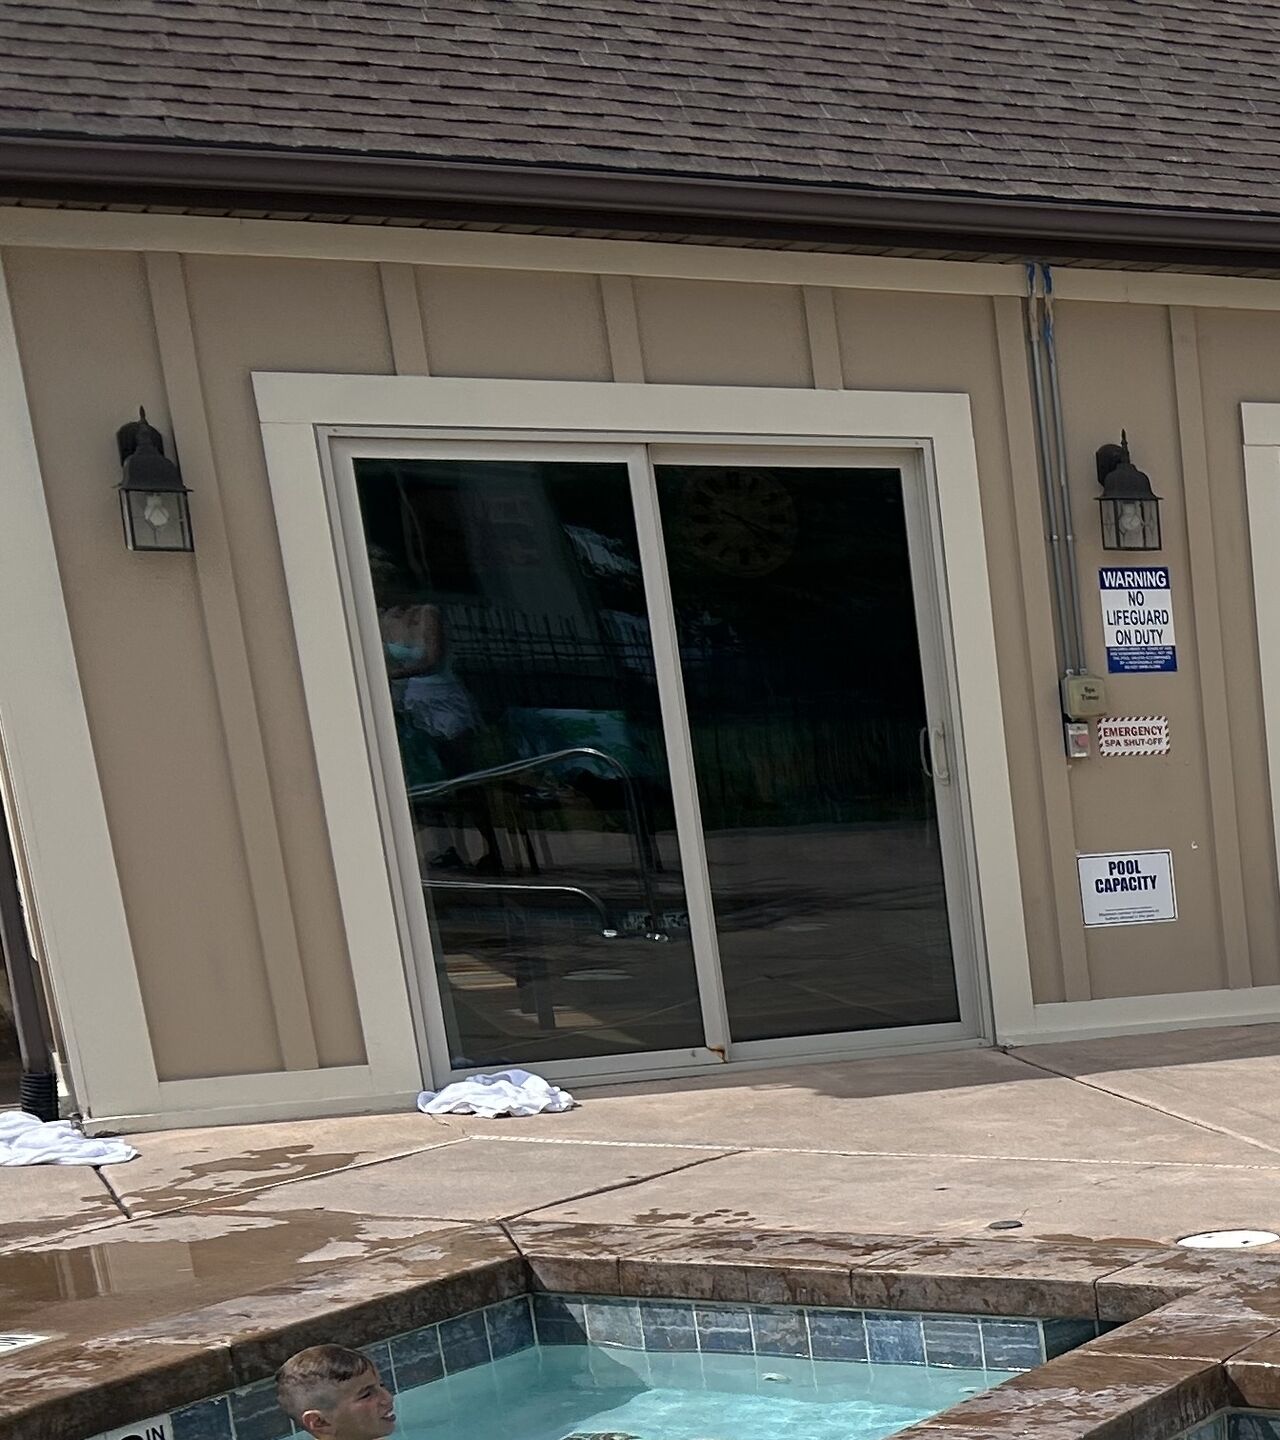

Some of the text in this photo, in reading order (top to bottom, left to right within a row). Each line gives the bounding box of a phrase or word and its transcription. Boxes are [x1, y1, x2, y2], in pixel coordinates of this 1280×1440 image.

[1102, 570, 1167, 588] WARNING
[1127, 590, 1145, 607] NO
[1106, 609, 1169, 626] LIFEGUARD
[1115, 629, 1164, 645] ON DUTY
[1103, 725, 1163, 737] EMERGENCY
[1104, 738, 1163, 747] SPA SHUT-OFF
[1108, 859, 1142, 876] POOL
[1095, 875, 1157, 894] CAPACITY
